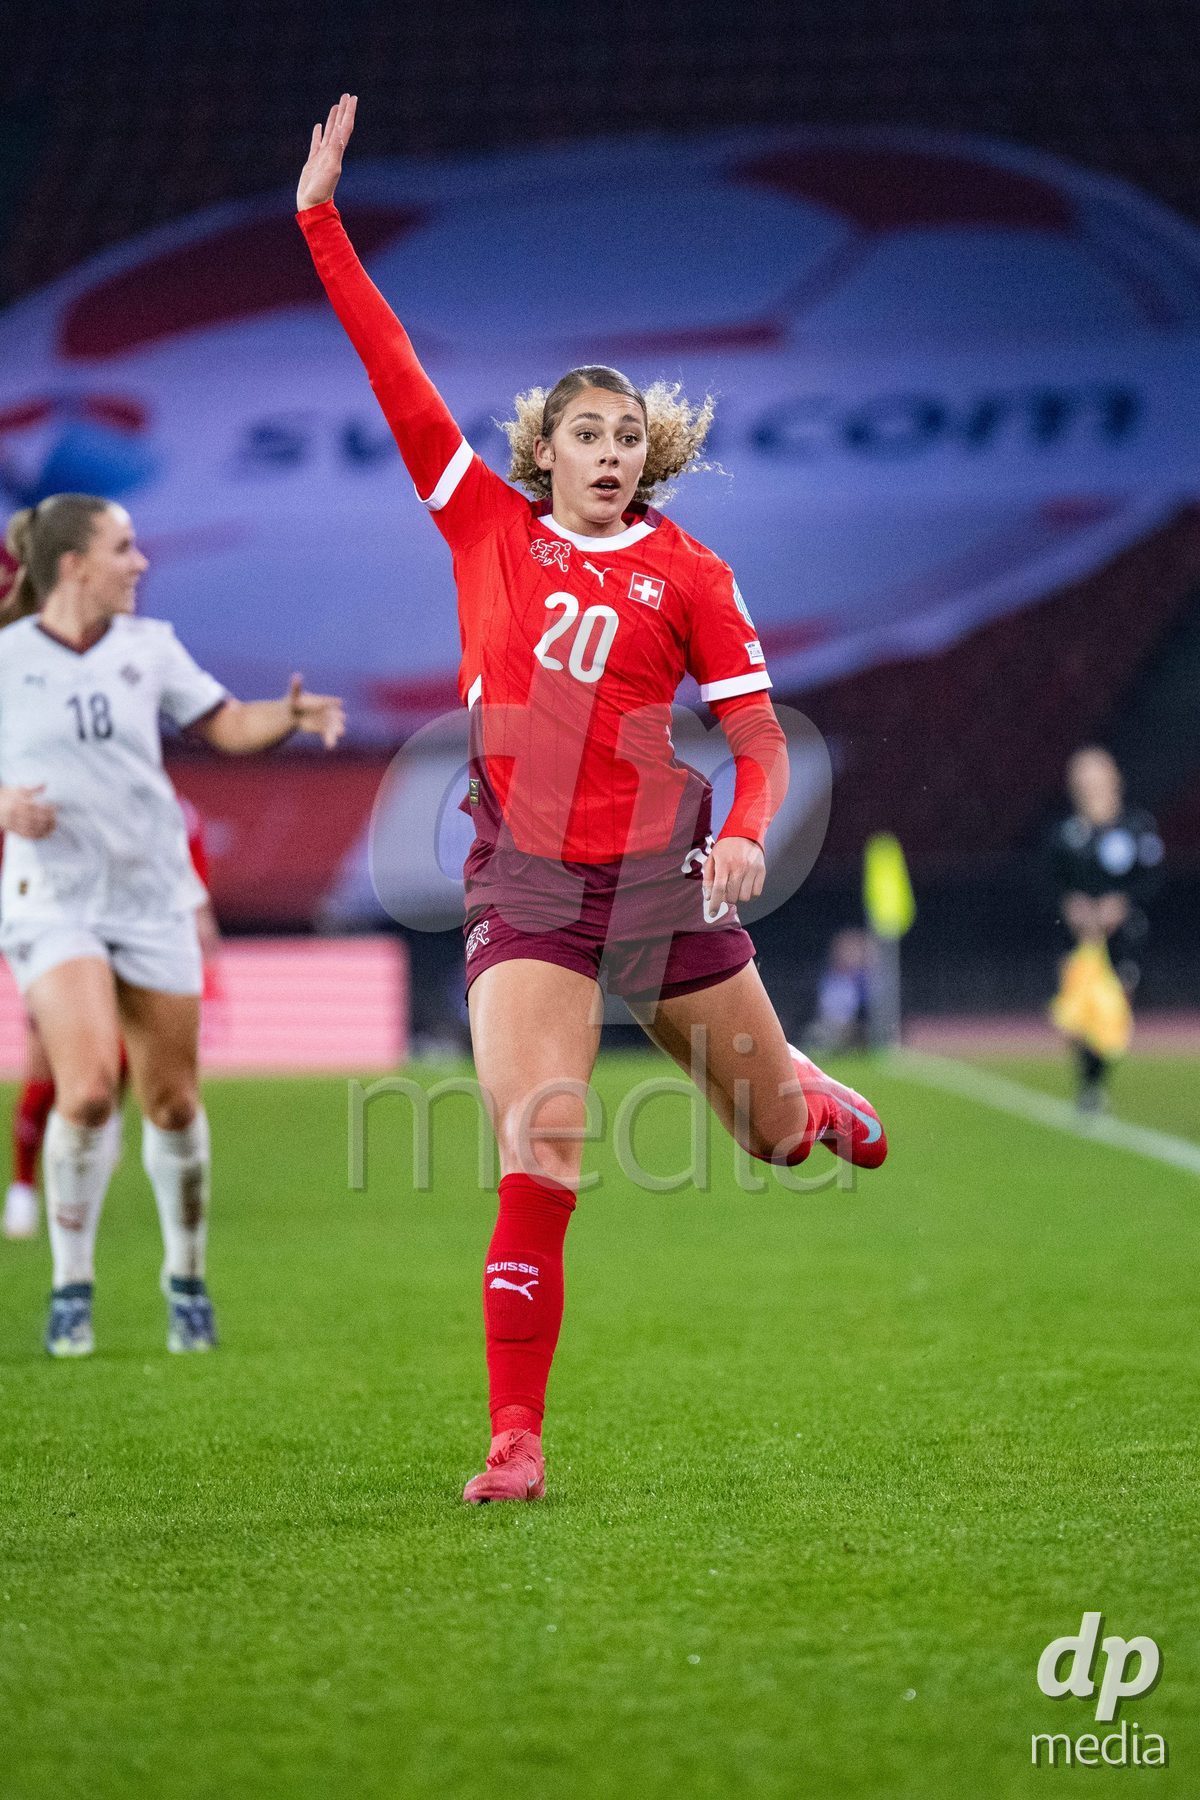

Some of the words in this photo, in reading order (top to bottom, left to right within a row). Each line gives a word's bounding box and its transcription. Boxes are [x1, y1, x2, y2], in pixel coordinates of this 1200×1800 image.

[533, 591, 620, 683] 20
[66, 691, 114, 742] 18
[486, 1261, 539, 1277] SUISSE
